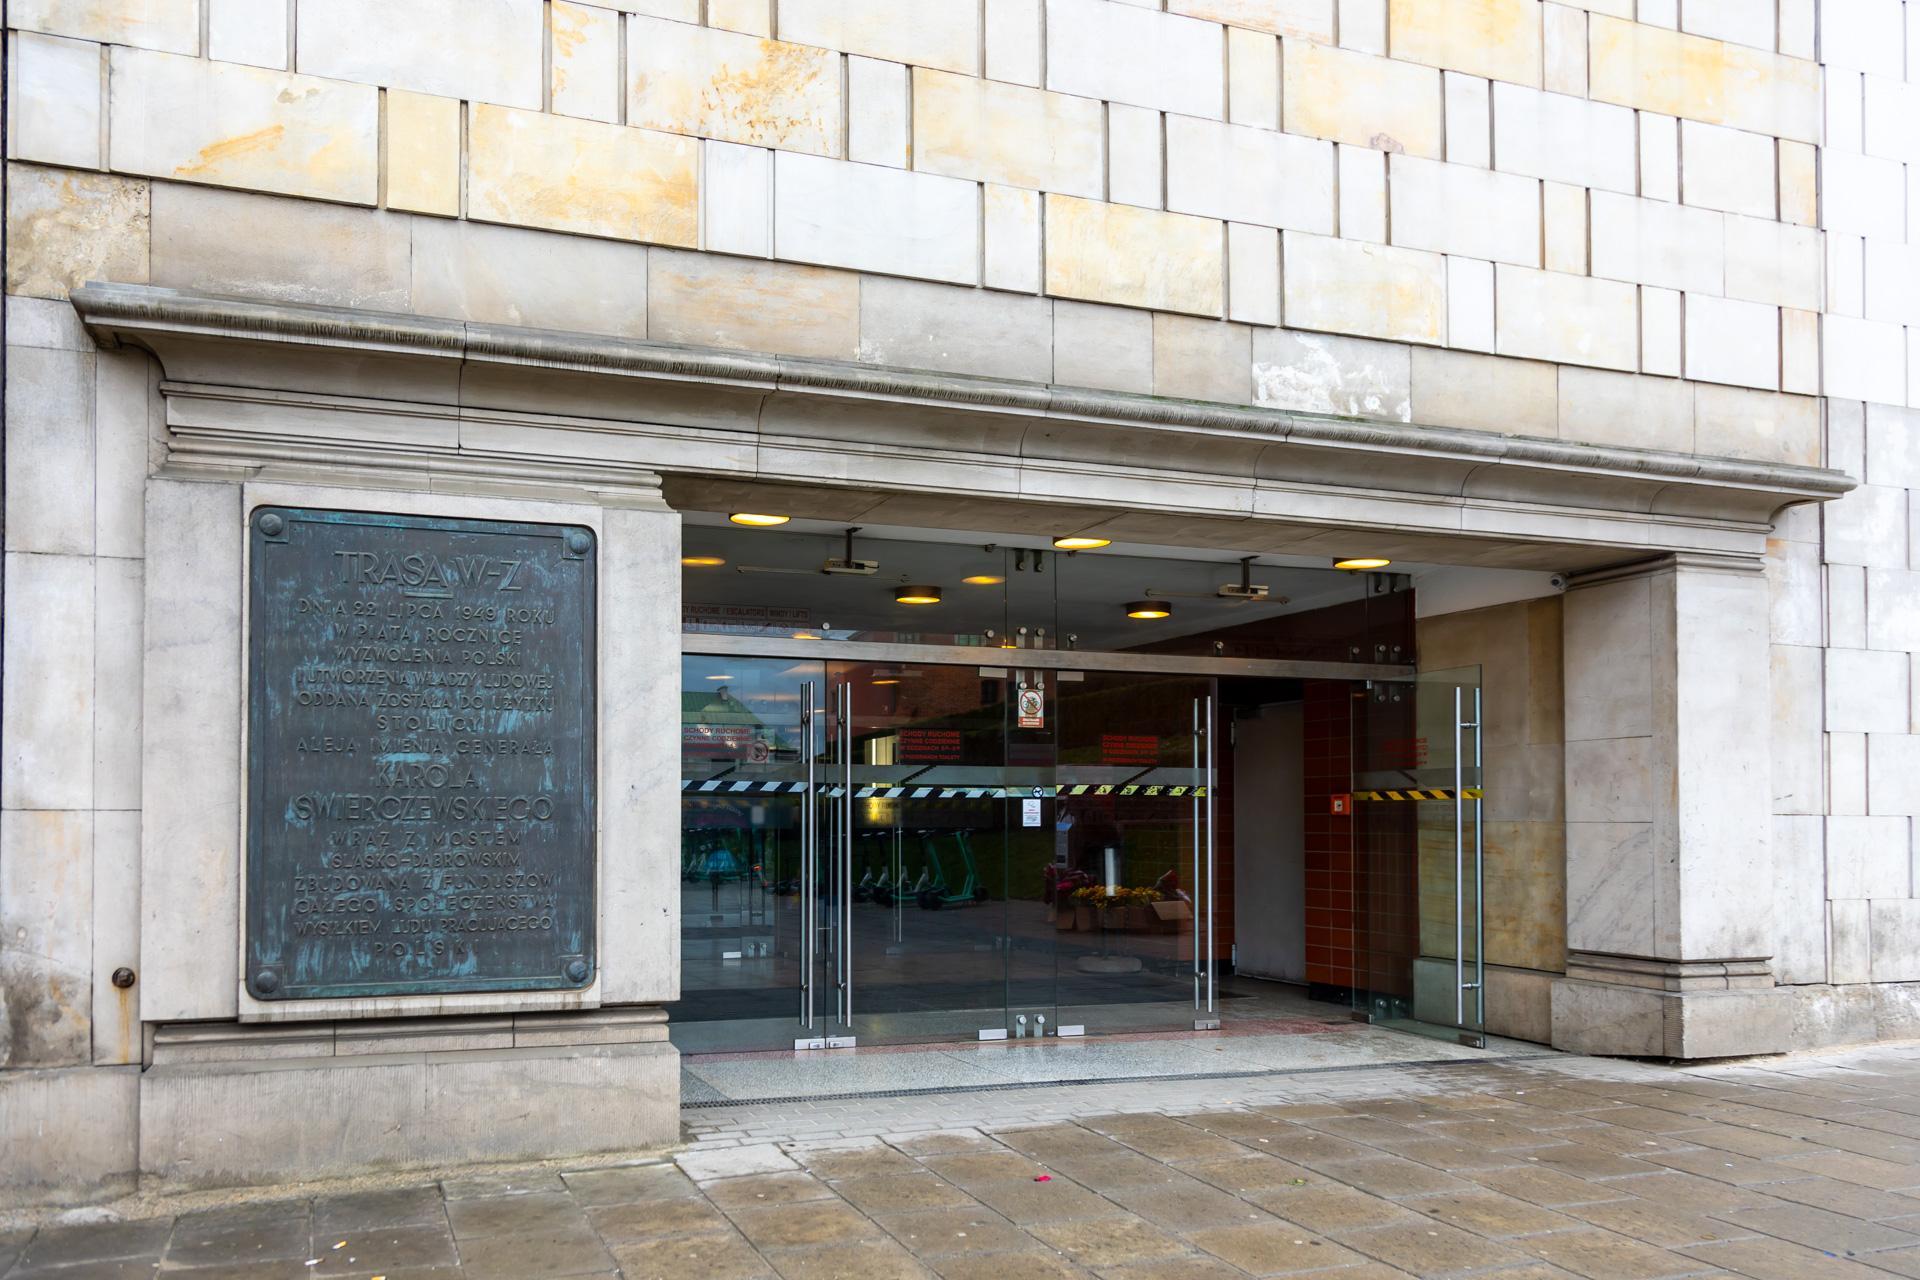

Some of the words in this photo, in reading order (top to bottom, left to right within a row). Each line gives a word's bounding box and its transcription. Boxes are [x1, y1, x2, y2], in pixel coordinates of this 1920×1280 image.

[334, 550, 449, 588] TRASA
[452, 556, 522, 591] W-Z
[299, 600, 347, 616] DNIA
[353, 601, 377, 617] 22
[388, 602, 444, 619] LIPCA
[454, 605, 496, 622] 1949
[505, 607, 555, 625] ROKU
[334, 623, 348, 638] W
[334, 646, 453, 666] WYZWOLENIA
[461, 650, 521, 668] POLSKI
[307, 668, 409, 687] UTWORZENIA
[483, 673, 554, 690] LUDOWEJ
[298, 691, 370, 708] ODDANA
[460, 695, 484, 711] DO
[376, 714, 482, 732] STOLICY
[296, 736, 357, 753] ALEJA
[369, 736, 444, 755] IMIENIA
[375, 764, 481, 789] KAROLA
[332, 831, 390, 847] WRAZ
[403, 831, 416, 847] Z
[432, 830, 522, 846] MOSTEM
[294, 874, 410, 893] ZBUDOWANA
[422, 874, 433, 890] Z
[392, 919, 432, 935] LUDU
[374, 940, 479, 957] POLSKI
